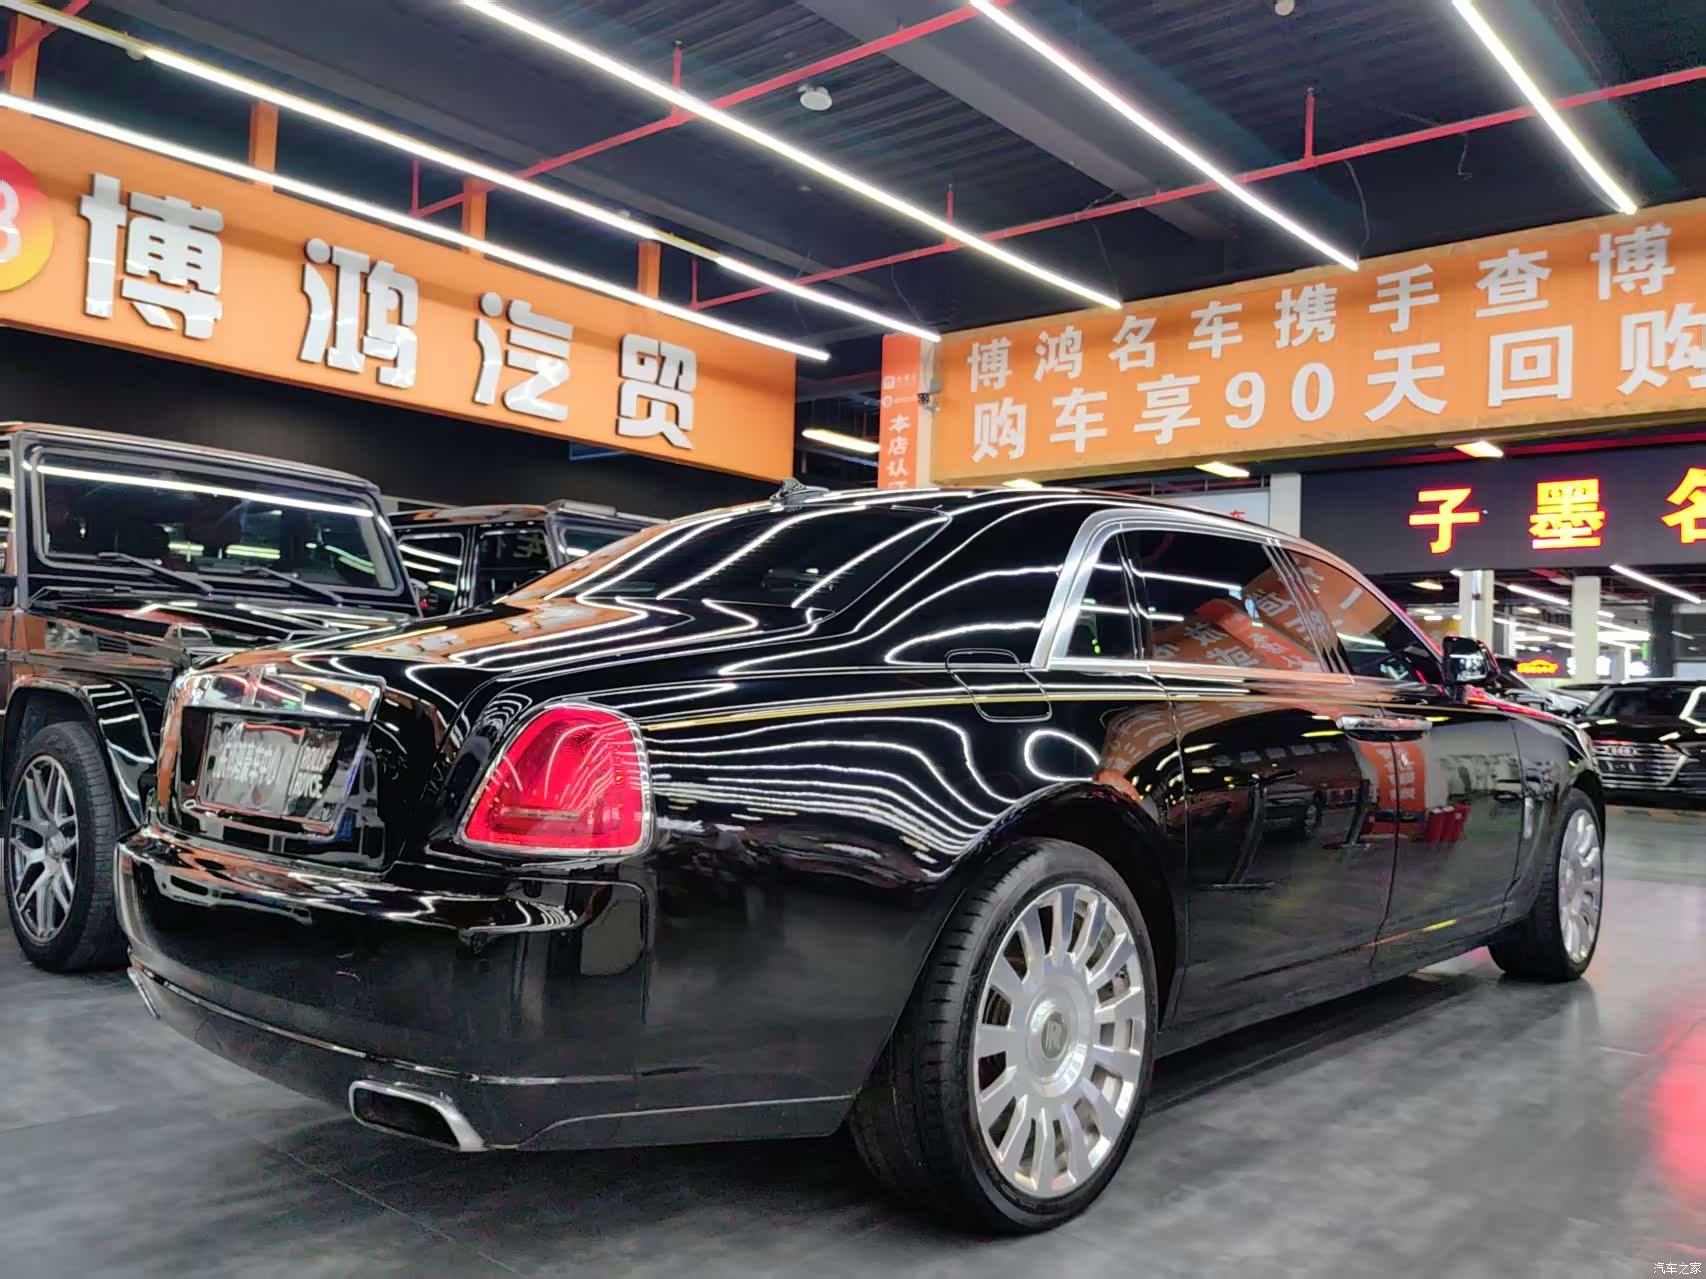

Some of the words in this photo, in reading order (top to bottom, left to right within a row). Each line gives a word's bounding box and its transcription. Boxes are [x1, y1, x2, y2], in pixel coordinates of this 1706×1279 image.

[80, 173, 697, 450] 博鸿汽贸
[967, 222, 1676, 393] 博鸿名车携手查博
